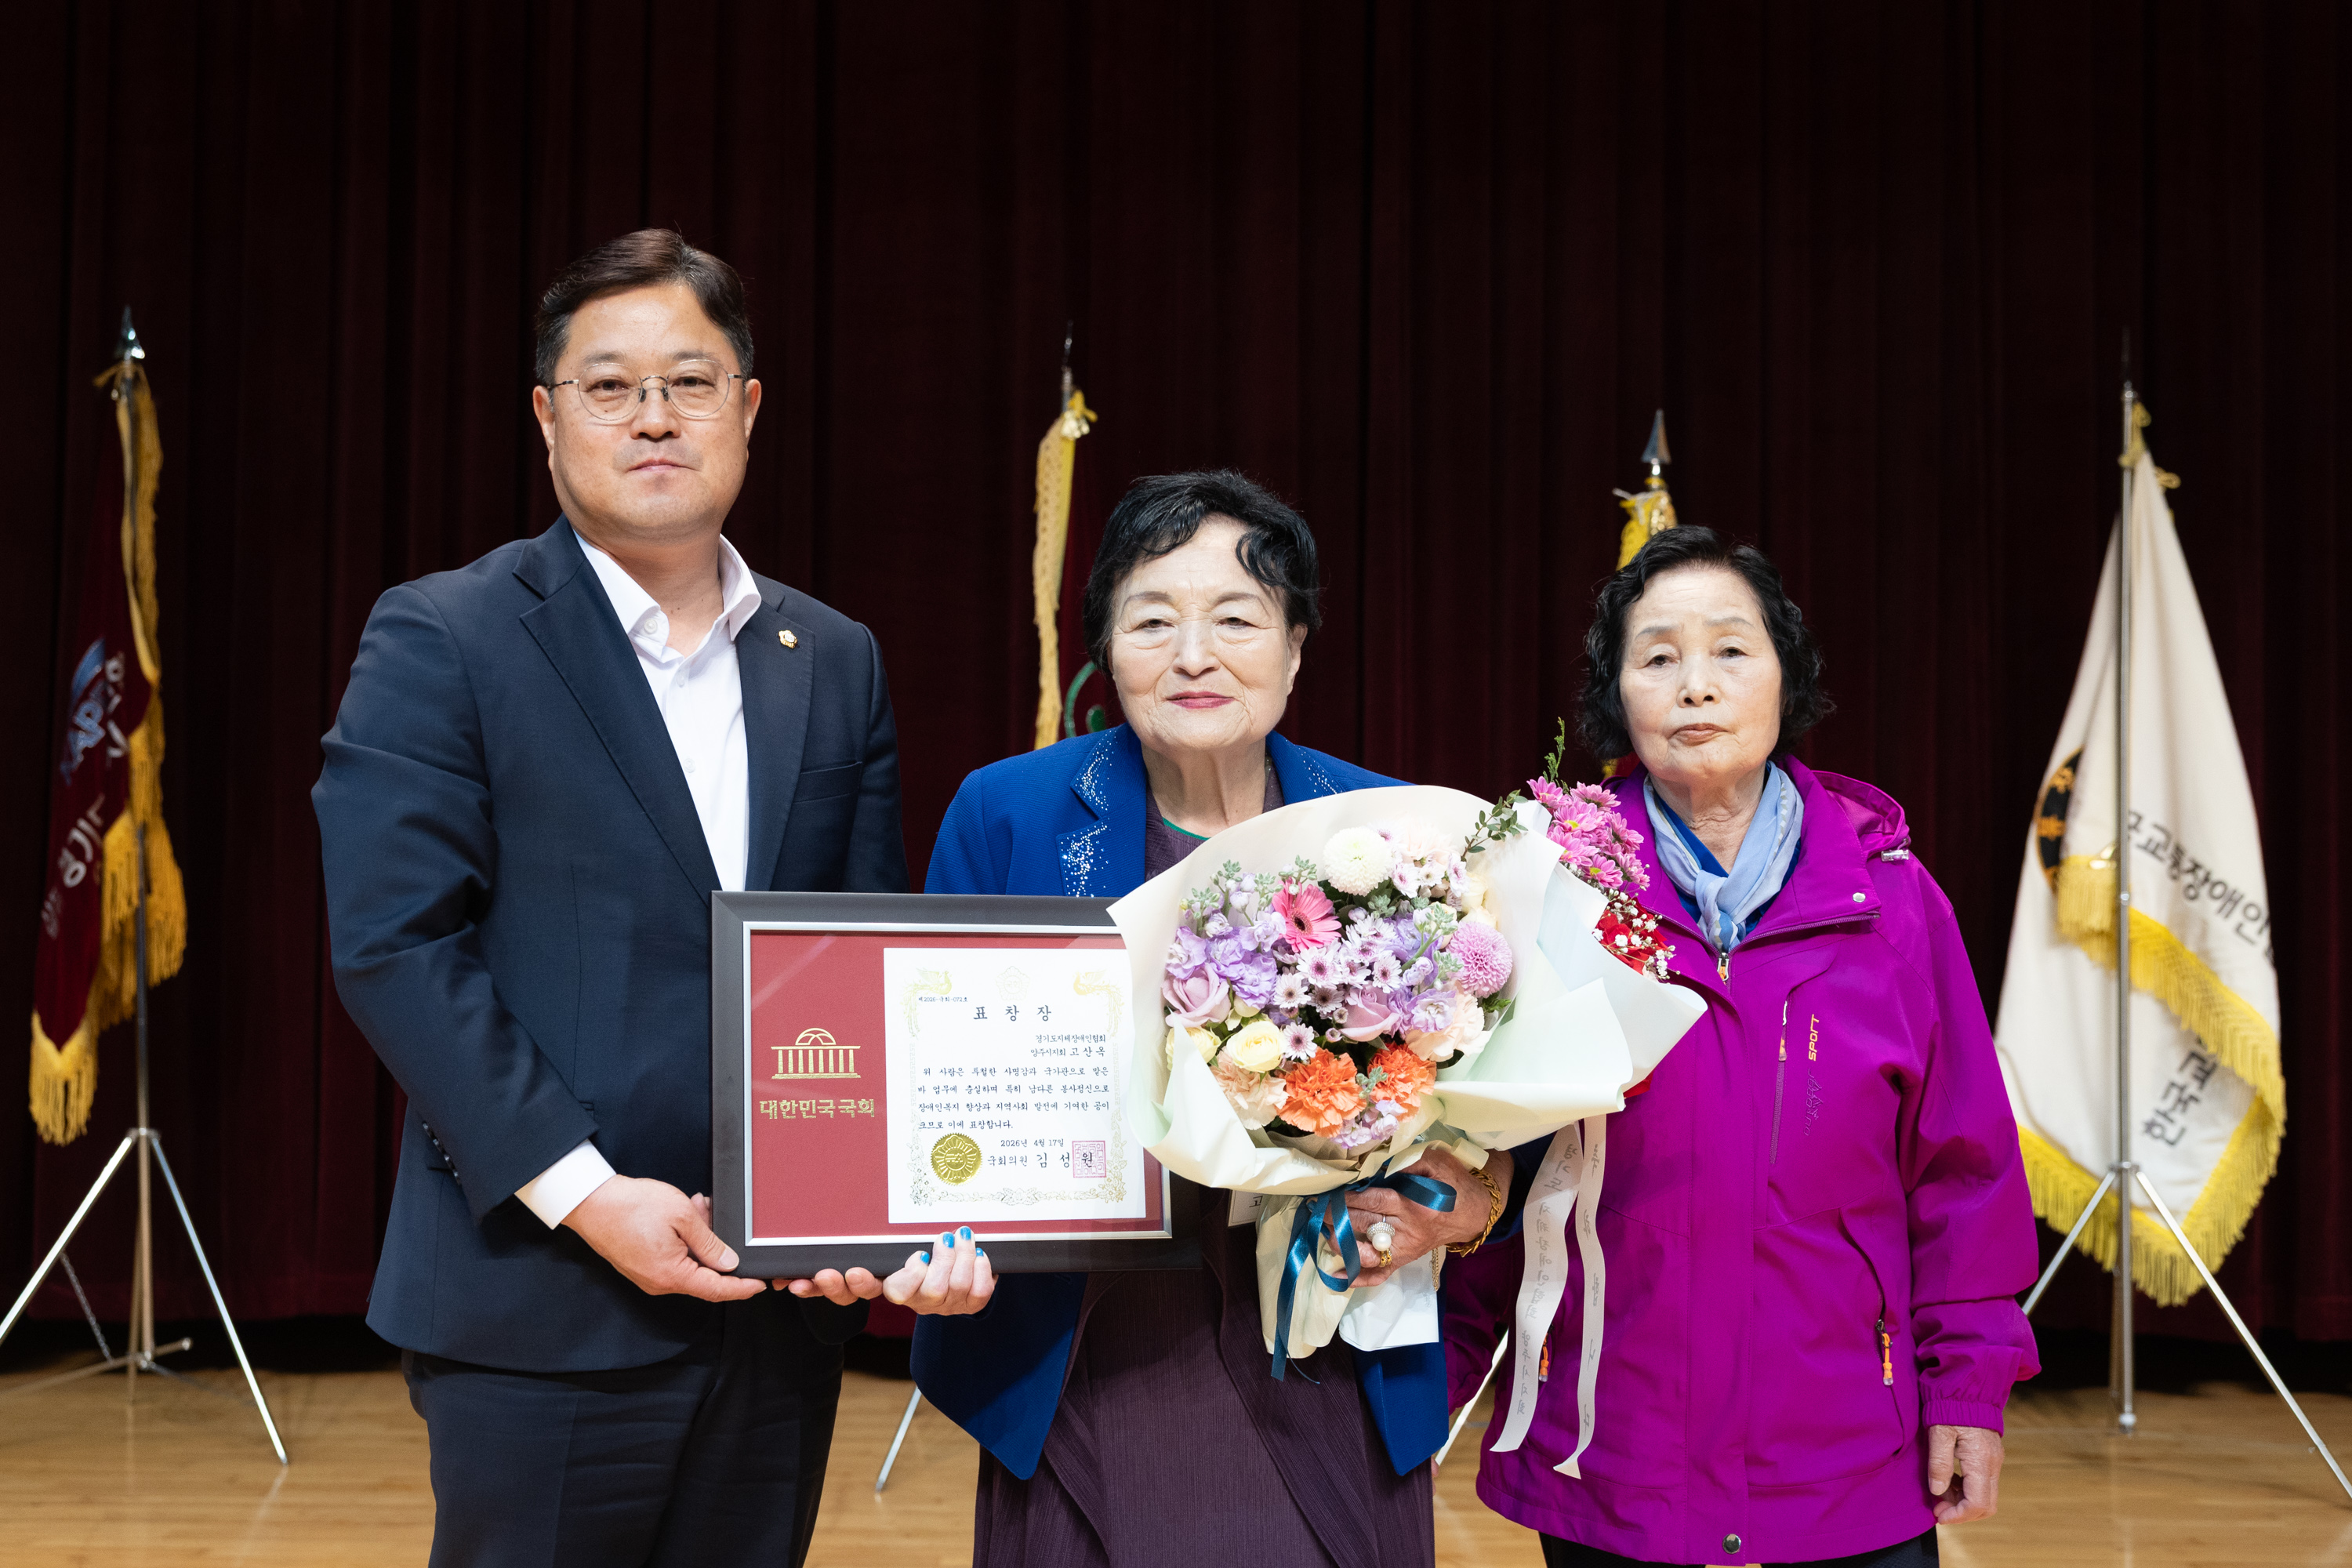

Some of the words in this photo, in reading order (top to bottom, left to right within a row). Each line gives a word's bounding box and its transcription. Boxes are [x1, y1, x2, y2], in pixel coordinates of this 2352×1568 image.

[1036, 1034, 1105, 1043] 경기도지체장애인협회
[1031, 1048, 1065, 1057] 양주시지회
[940, 1068, 964, 1076] 사람은
[972, 1067, 996, 1076] 투철한
[1004, 1067, 1036, 1076] 사명감과
[1044, 1067, 1085, 1076] 국가관으로
[933, 1085, 956, 1094] 업무에
[966, 1085, 996, 1094] 충실하며
[1006, 1085, 1020, 1094] 특히
[1029, 1085, 1053, 1094] 남다른
[1061, 1084, 1109, 1094] 봉사정신으로
[2143, 1046, 2217, 1146] 한국교
[759, 1098, 874, 1119] 대한민국국회
[919, 1103, 959, 1112] 장애인복지
[966, 1102, 990, 1112] 향상과
[996, 1102, 1027, 1111] 지역사회
[1034, 1102, 1058, 1111] 발전에
[1065, 1102, 1088, 1111] 기여한
[1094, 1102, 1109, 1110] 공이
[949, 1120, 964, 1129] 이에
[970, 1120, 1013, 1129] 표창합니다.
[1049, 1138, 1063, 1147] 17일
[988, 1156, 1027, 1167] 국회의원
